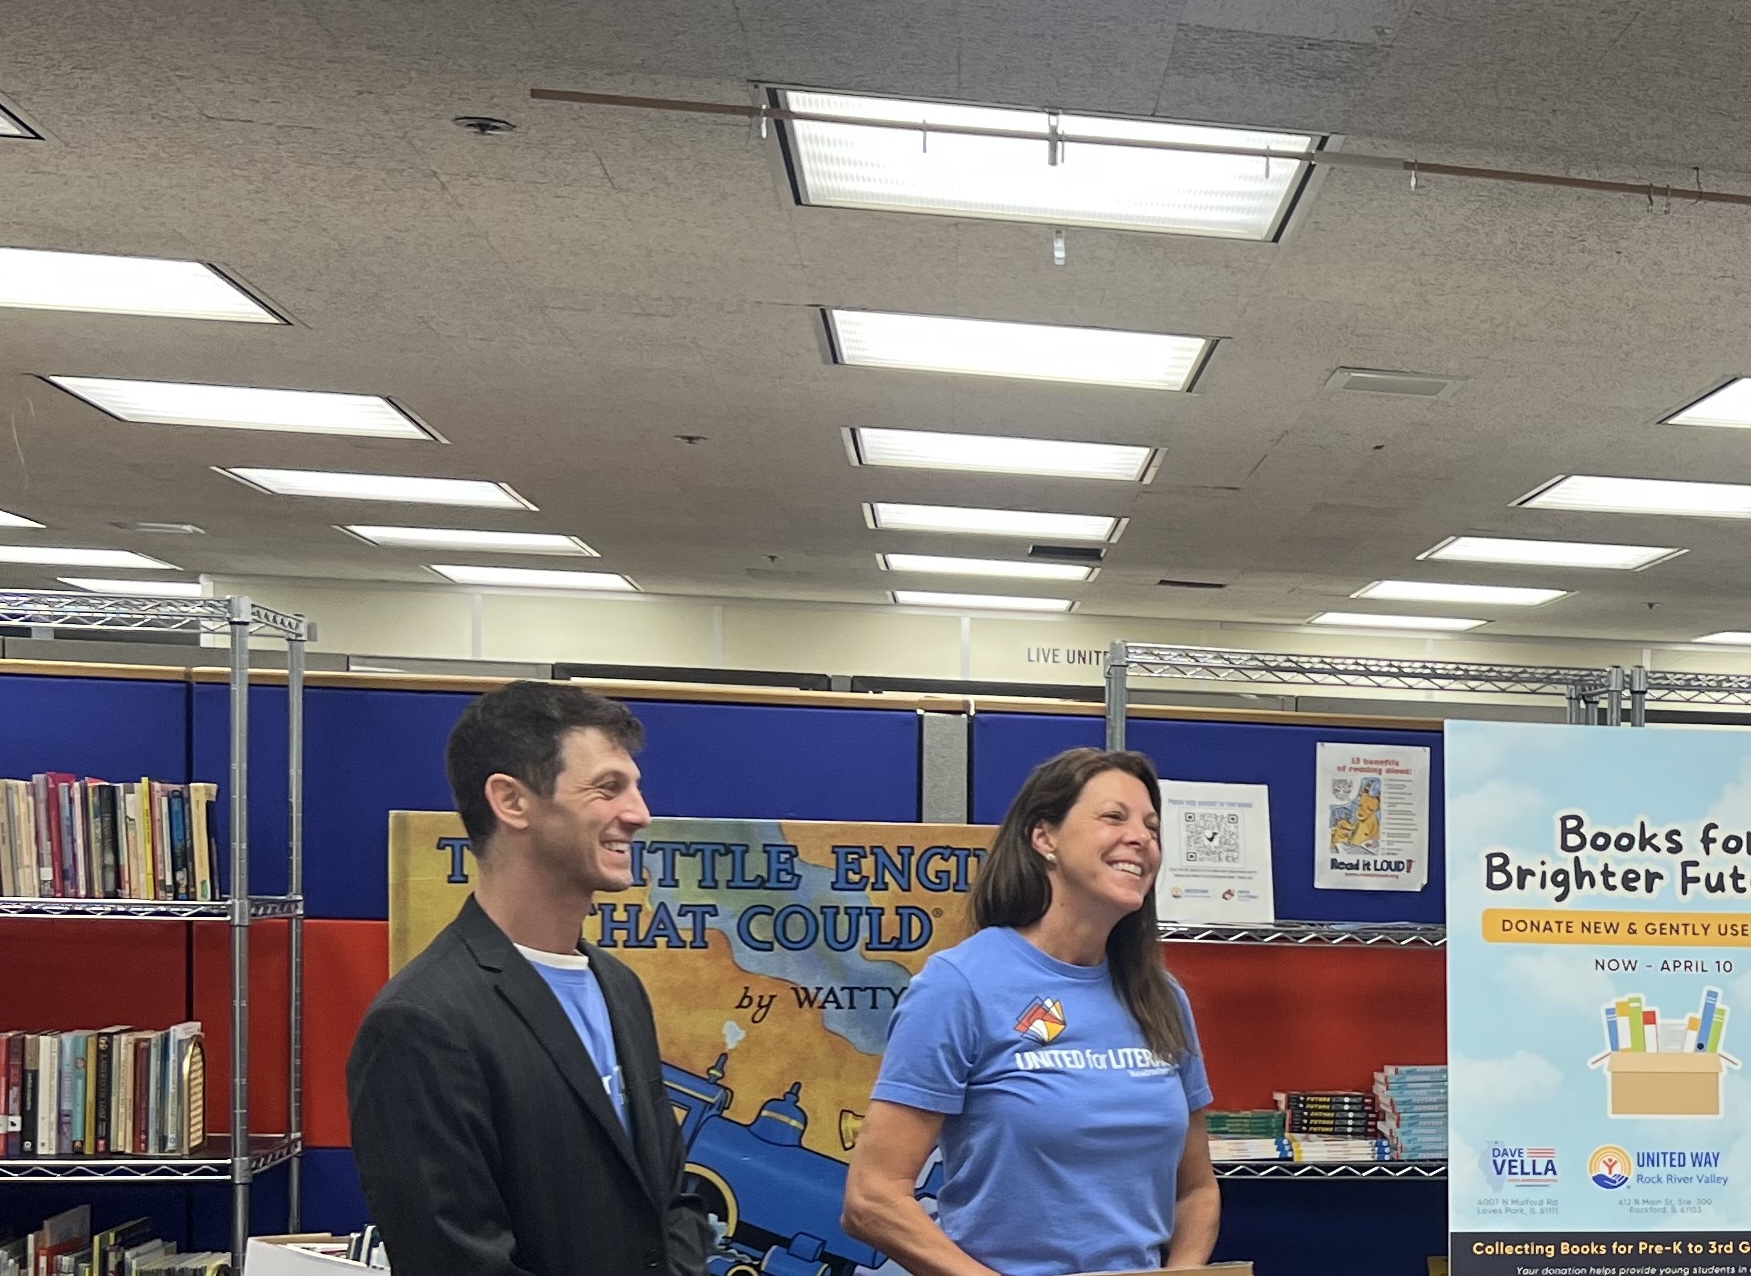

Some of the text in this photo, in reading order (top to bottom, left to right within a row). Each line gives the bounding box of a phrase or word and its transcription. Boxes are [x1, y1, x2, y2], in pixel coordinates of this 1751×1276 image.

[1027, 647, 1110, 665] LIVE UNIT
[1559, 814, 1683, 856] Books
[630, 841, 801, 889] ITTLE
[1330, 858, 1360, 872] Read
[1362, 858, 1372, 872] it
[1485, 852, 1665, 902] Brighter
[737, 905, 933, 951] COULD
[1501, 918, 1575, 936] DONATE
[1580, 920, 1621, 937] NEW
[1626, 921, 1639, 936] &
[1644, 922, 1712, 938] GENTLY
[1594, 958, 1734, 973] NOW APRIL 10
[735, 986, 909, 1023] by WATTY
[1015, 1048, 1108, 1071] UNITED for
[1492, 1147, 1524, 1158] DAVE
[1636, 1151, 1721, 1168] UNITED WAY
[1492, 1159, 1557, 1176] VELLA
[1636, 1174, 1729, 1187] Rock River Valley
[1472, 1241, 1555, 1258] Collecting
[1560, 1241, 1607, 1255] Books
[1612, 1241, 1634, 1255] for
[1638, 1241, 1683, 1255] Pre-K
[1688, 1241, 1703, 1254] to
[1708, 1241, 1734, 1254] 3rd
